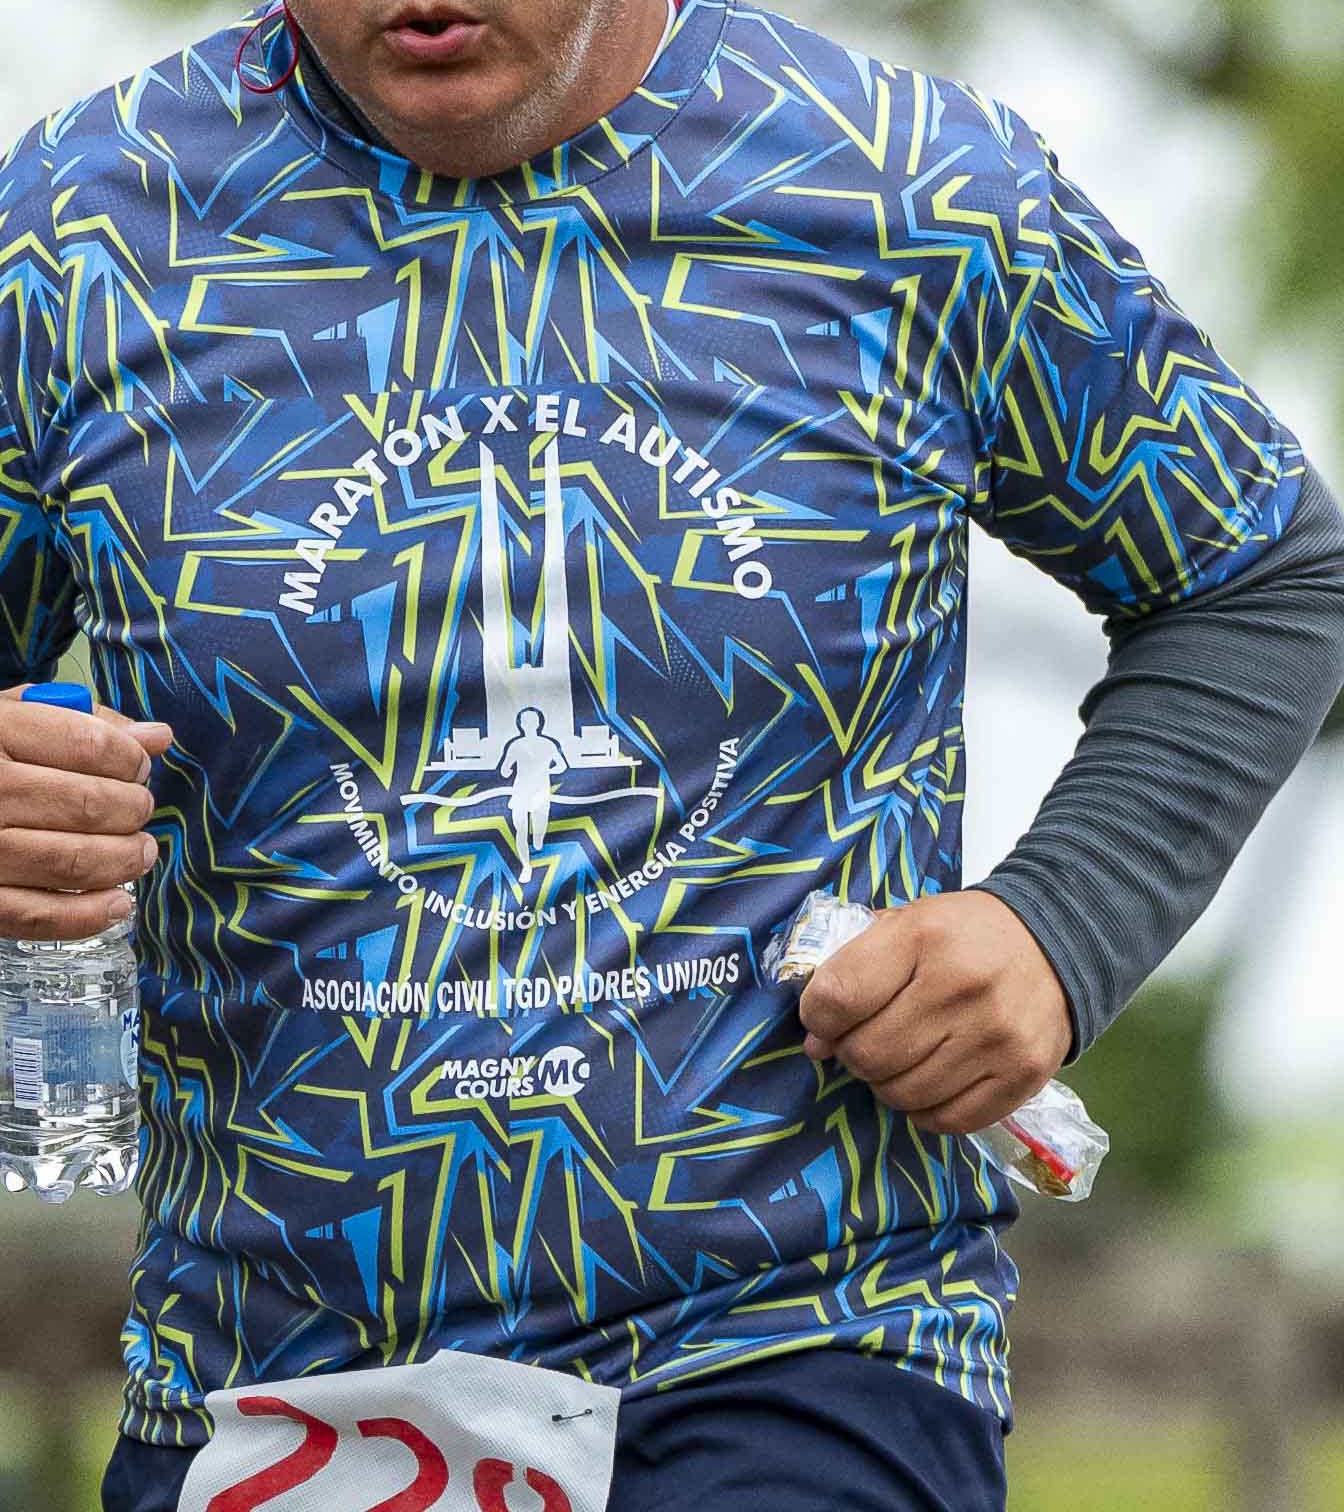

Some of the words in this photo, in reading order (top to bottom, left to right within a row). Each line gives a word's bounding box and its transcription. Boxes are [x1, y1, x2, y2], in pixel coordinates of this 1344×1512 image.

[278, 405, 465, 615] MARATÓN
[479, 394, 519, 434] X
[535, 394, 587, 438] EL
[599, 412, 773, 599] AUTISMO
[424, 890, 556, 931] INCLUSIÓN
[561, 899, 578, 921] Y
[584, 841, 687, 914] ENERGÍA
[678, 737, 740, 843] POSITIVA
[301, 973, 430, 1013] ASOCIACIÓN
[437, 979, 498, 1013] CIVIL
[503, 977, 551, 1010] TGD
[557, 967, 651, 1006] PADRES
[657, 953, 740, 995] UNIDOS
[440, 1055, 537, 1080] MAGNY
[454, 1076, 535, 1099] COURS
